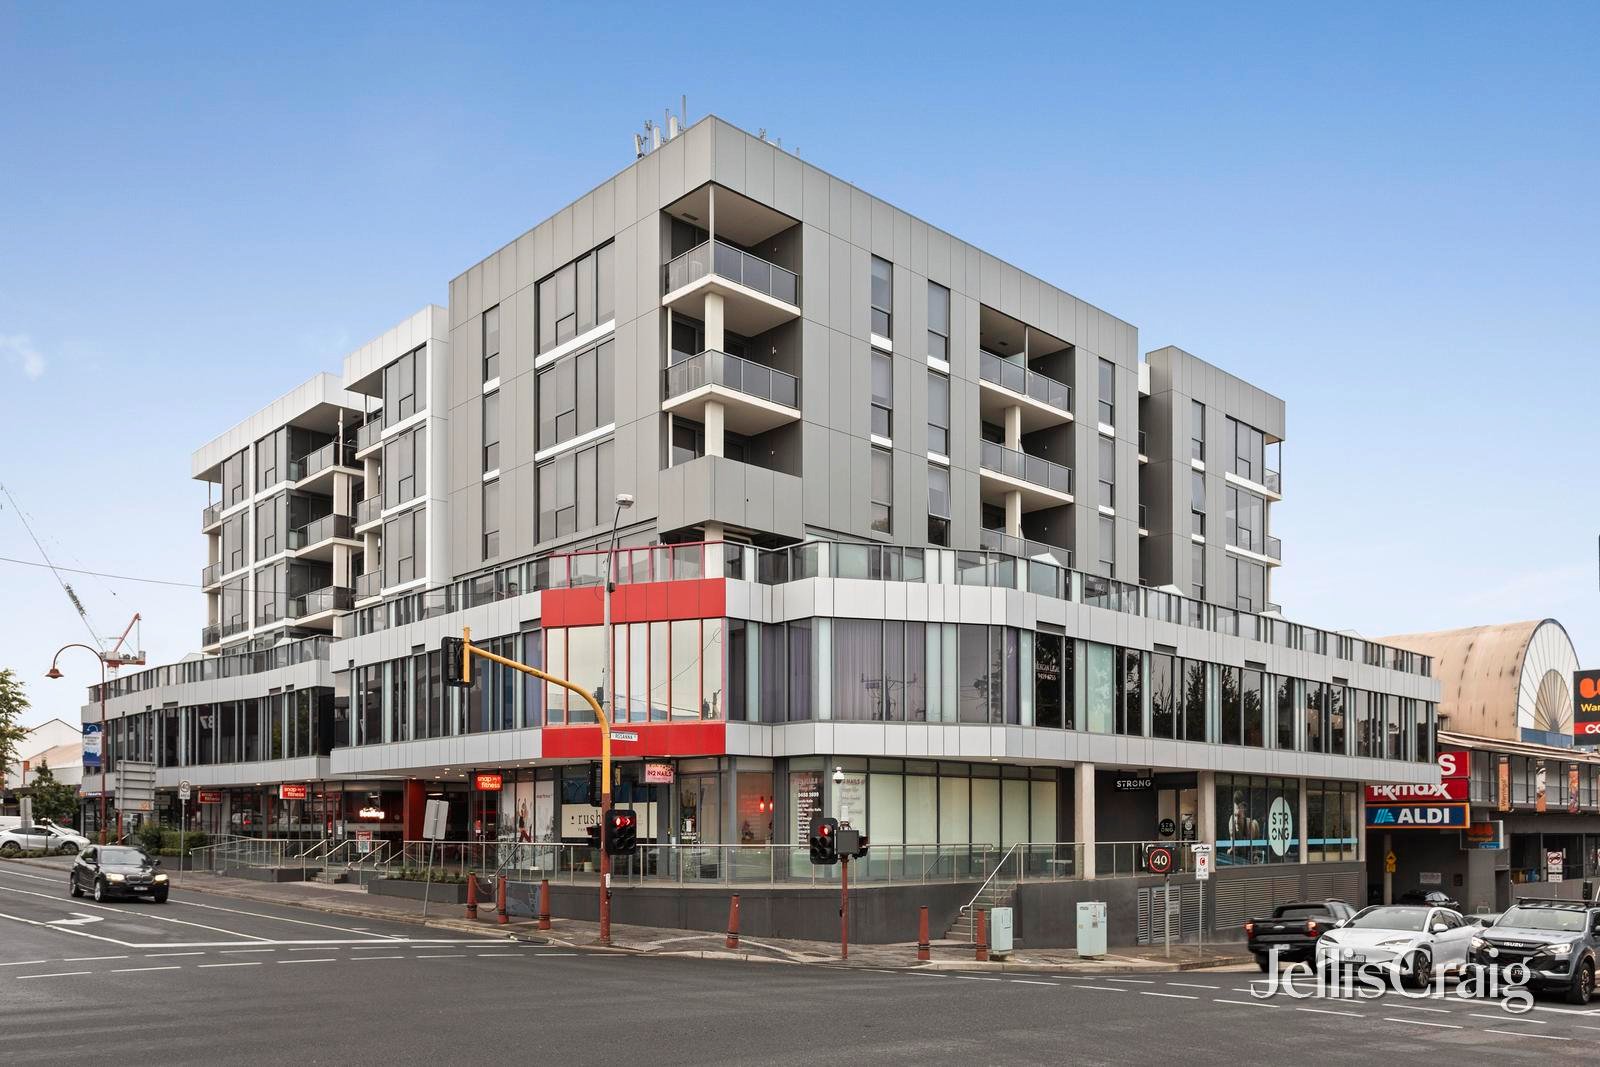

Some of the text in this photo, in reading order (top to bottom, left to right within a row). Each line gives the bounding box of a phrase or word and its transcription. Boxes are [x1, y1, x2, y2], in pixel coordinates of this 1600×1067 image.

[1116, 779, 1151, 788] STRONG
[1271, 812, 1289, 825] STR
[1397, 807, 1450, 824] ALDI
[1271, 828, 1290, 840] ONG
[1154, 855, 1168, 866] 40
